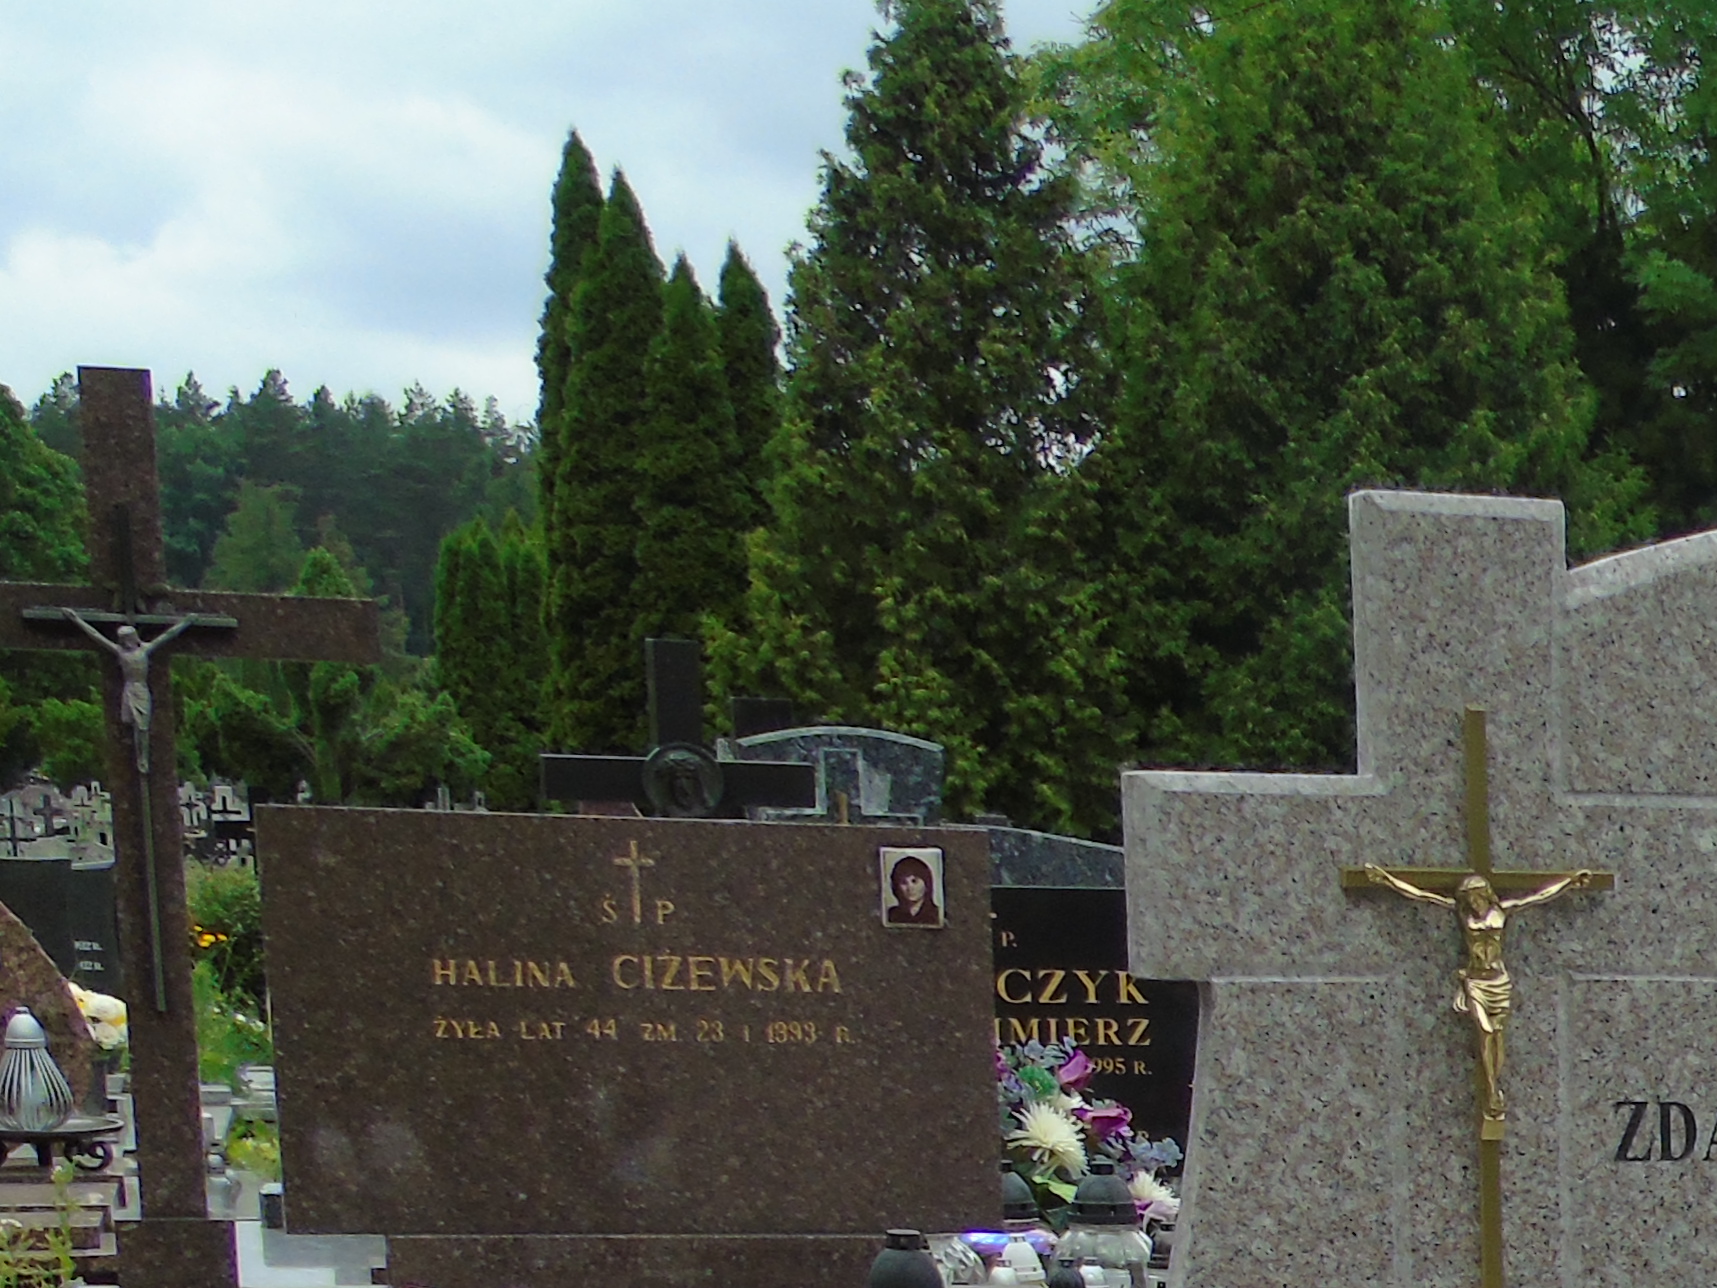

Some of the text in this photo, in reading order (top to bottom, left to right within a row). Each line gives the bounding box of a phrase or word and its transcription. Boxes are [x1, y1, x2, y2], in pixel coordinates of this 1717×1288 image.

[432, 949, 842, 995] HALINA CIŻEWSKA
[433, 1014, 501, 1041] ŻYŁA
[519, 1021, 567, 1042] LAT
[586, 1018, 618, 1041] 44
[1092, 1057, 1127, 1075] 995
